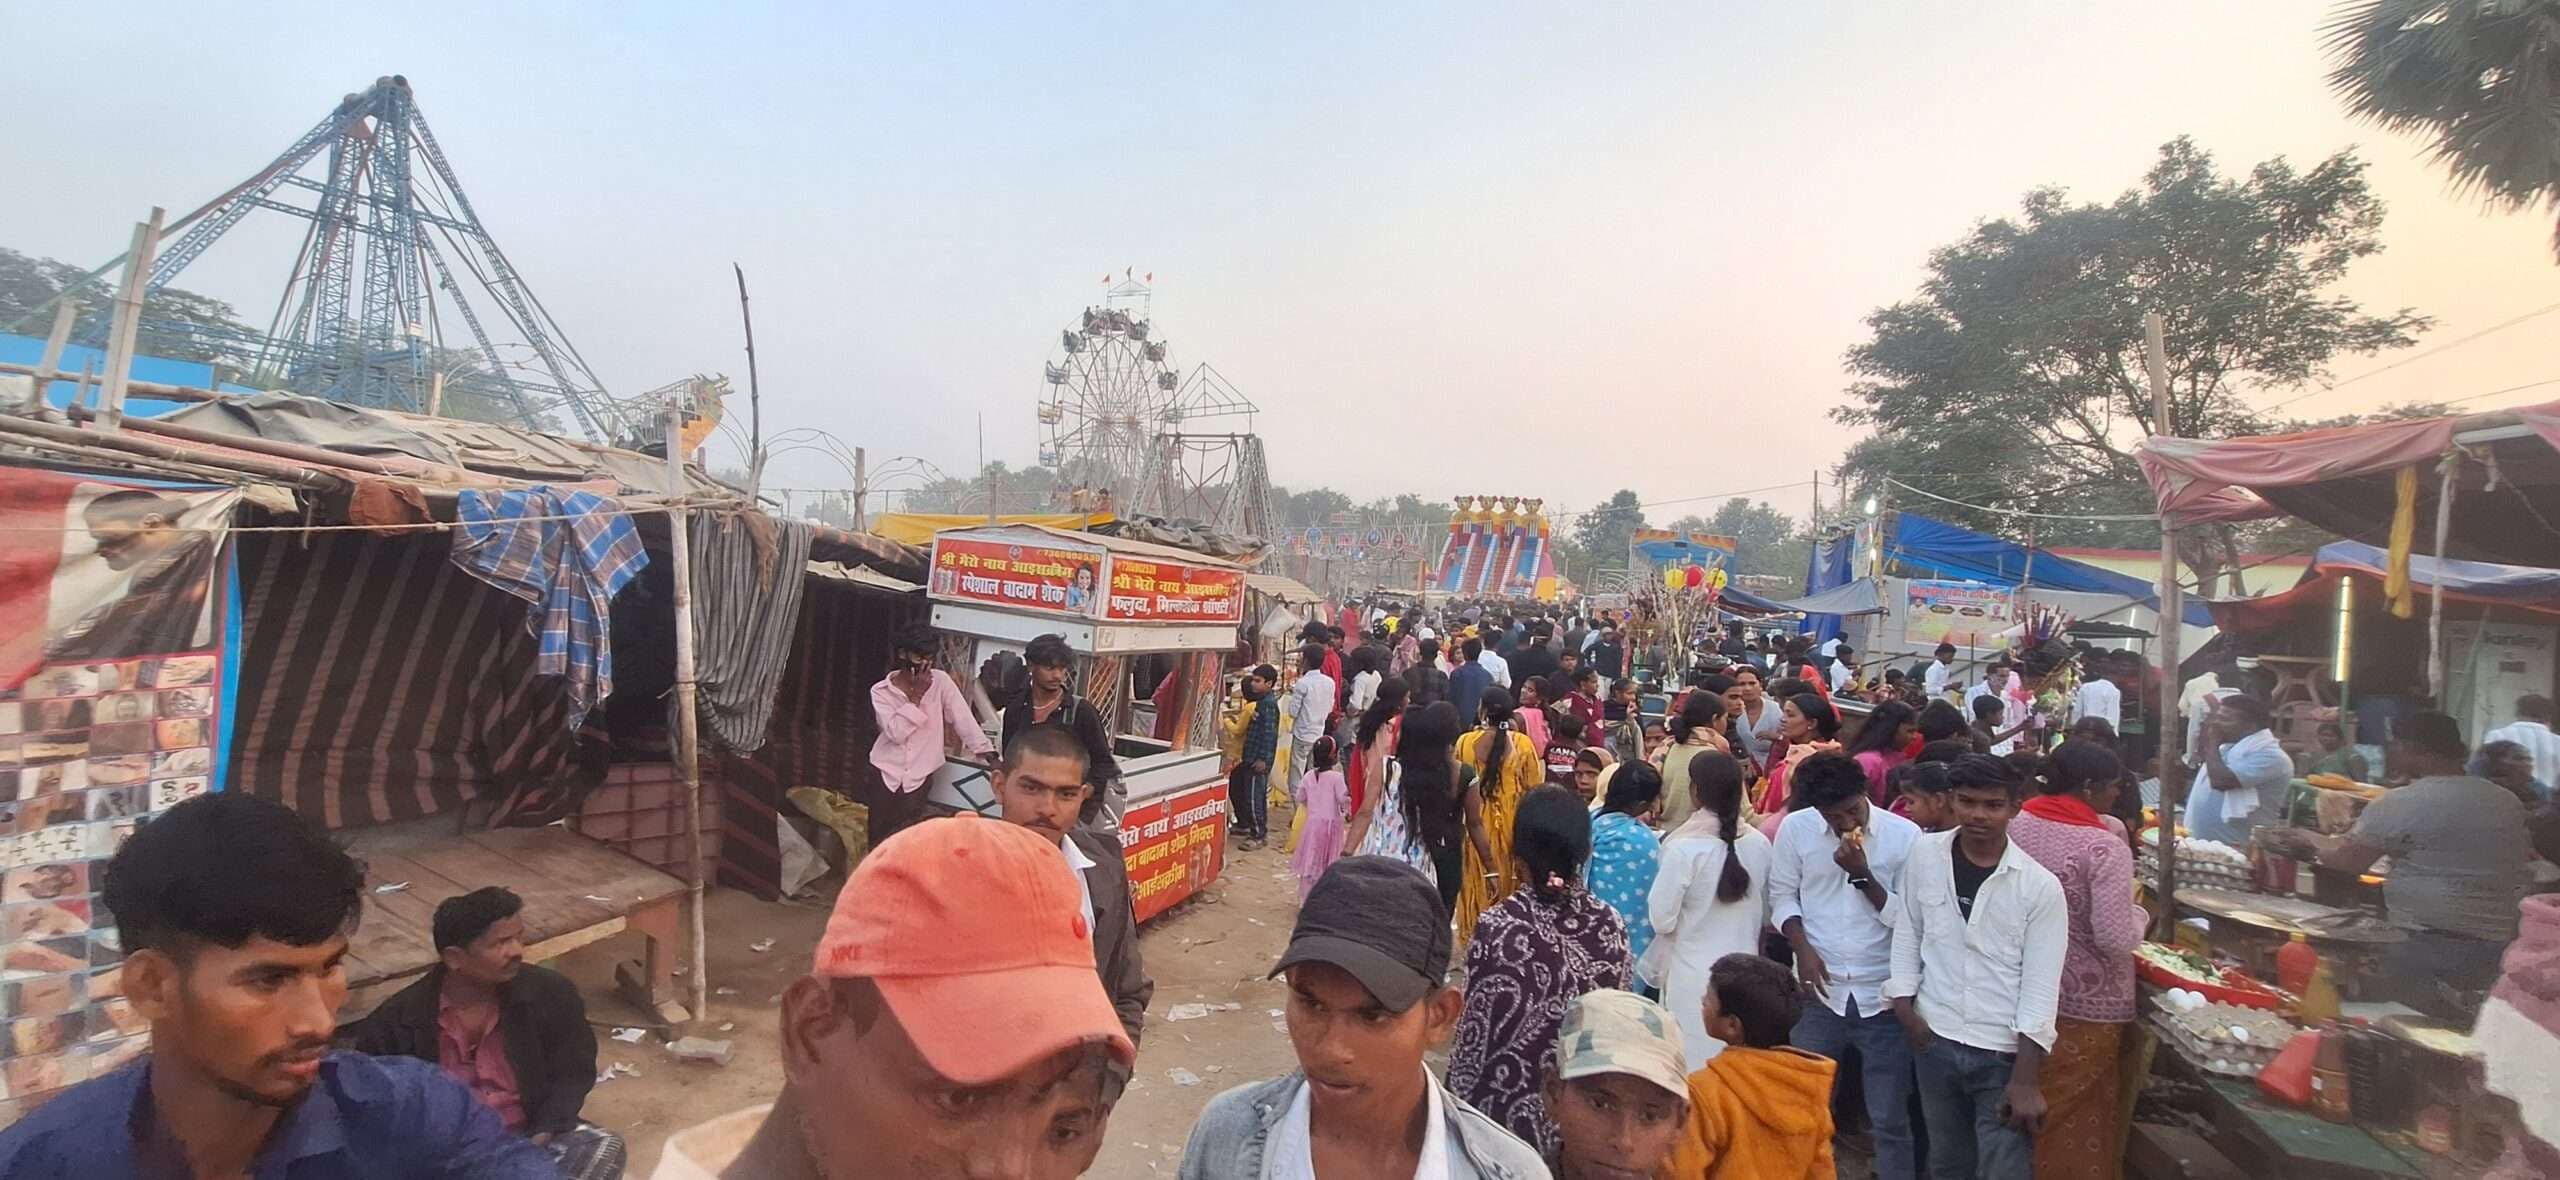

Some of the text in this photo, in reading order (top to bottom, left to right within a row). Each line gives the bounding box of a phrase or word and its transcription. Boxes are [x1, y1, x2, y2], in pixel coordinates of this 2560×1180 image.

[941, 551, 956, 566] श्री
[1003, 580, 1039, 601] बादाम
[1041, 580, 1067, 603] शेक
[1112, 573, 1131, 590] श्री
[1143, 817, 1170, 839] नाथ
[1138, 840, 1169, 866] बादाम
